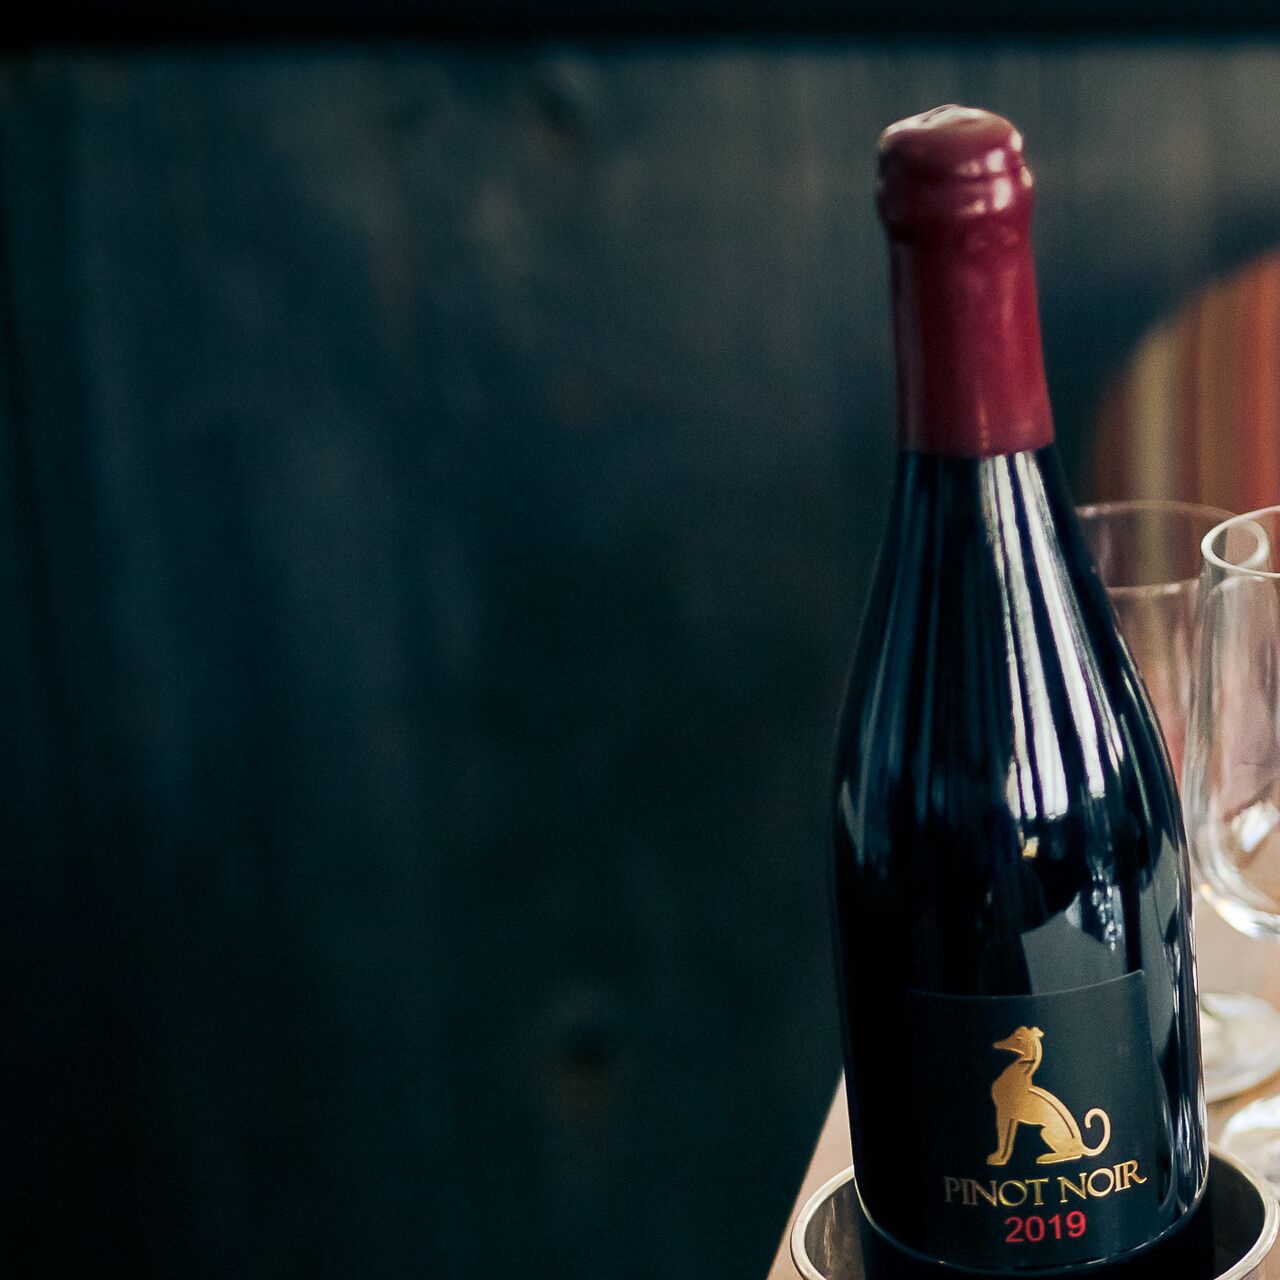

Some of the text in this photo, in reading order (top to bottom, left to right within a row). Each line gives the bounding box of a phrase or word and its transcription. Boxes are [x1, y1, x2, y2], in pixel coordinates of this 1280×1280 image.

[944, 1160, 1148, 1206] PINOT NOIR
[1005, 1211, 1087, 1243] 2019
